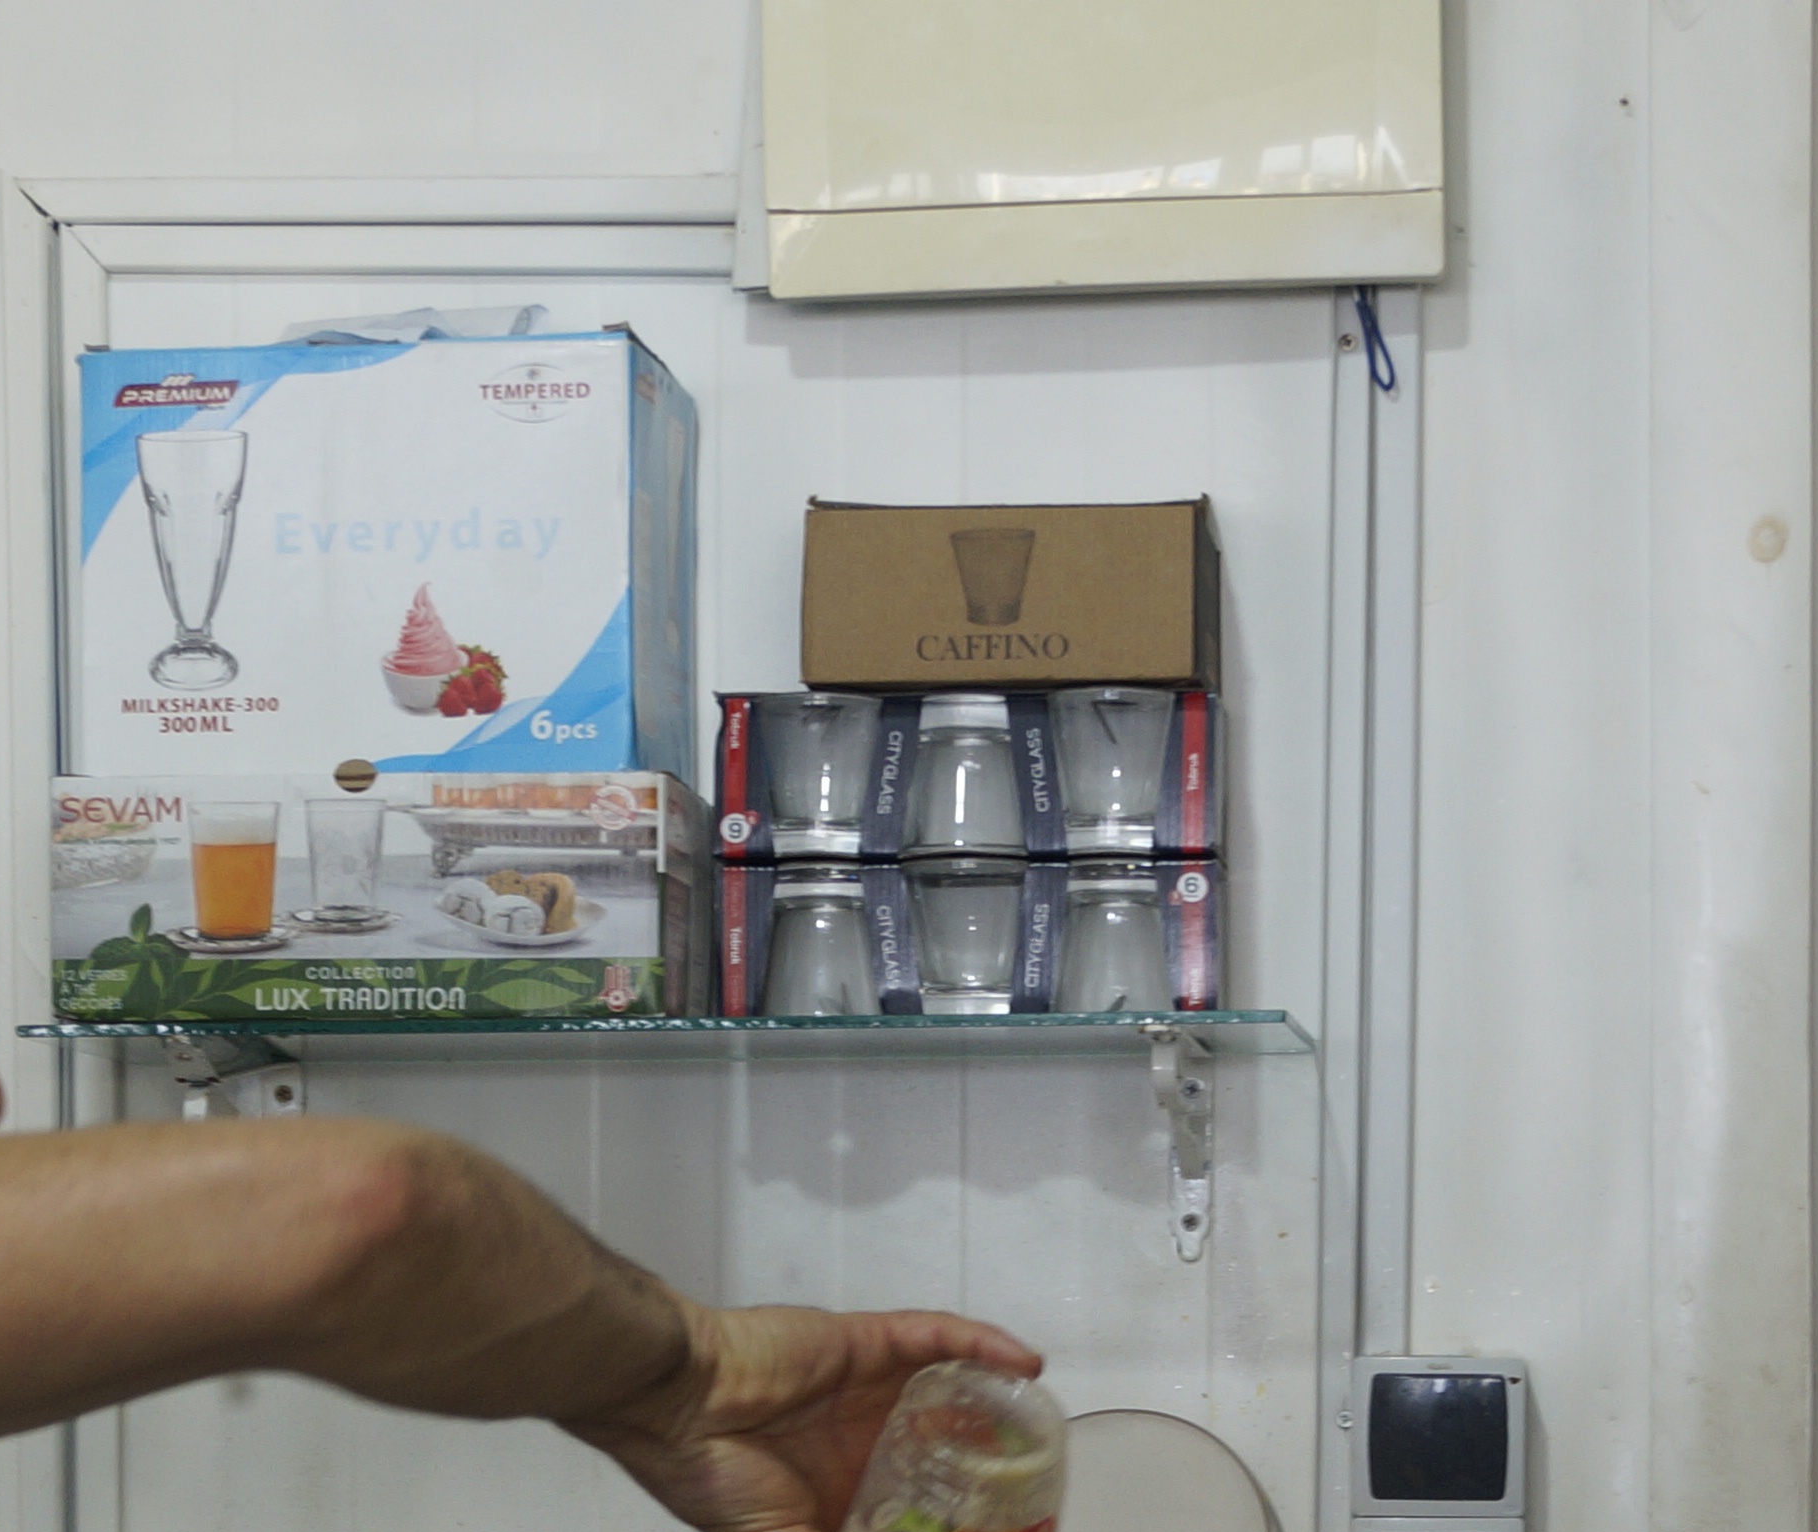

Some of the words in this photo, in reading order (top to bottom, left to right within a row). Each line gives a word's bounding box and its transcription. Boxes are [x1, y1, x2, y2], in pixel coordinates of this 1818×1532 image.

[121, 386, 230, 404] PREMIUM
[479, 382, 590, 400] TEMPERED
[276, 509, 562, 562] Everyday
[916, 633, 1070, 663] CAFFINO
[121, 697, 280, 714] MILKSHAKE-300
[158, 715, 234, 733] 300ML
[530, 709, 598, 745] 6pcs
[1027, 727, 1051, 813] CITYGLASS
[59, 796, 183, 823] SEVAM
[305, 965, 416, 980] COLLECTION
[255, 987, 312, 1011] LUX
[319, 986, 467, 1011] TRADITION
